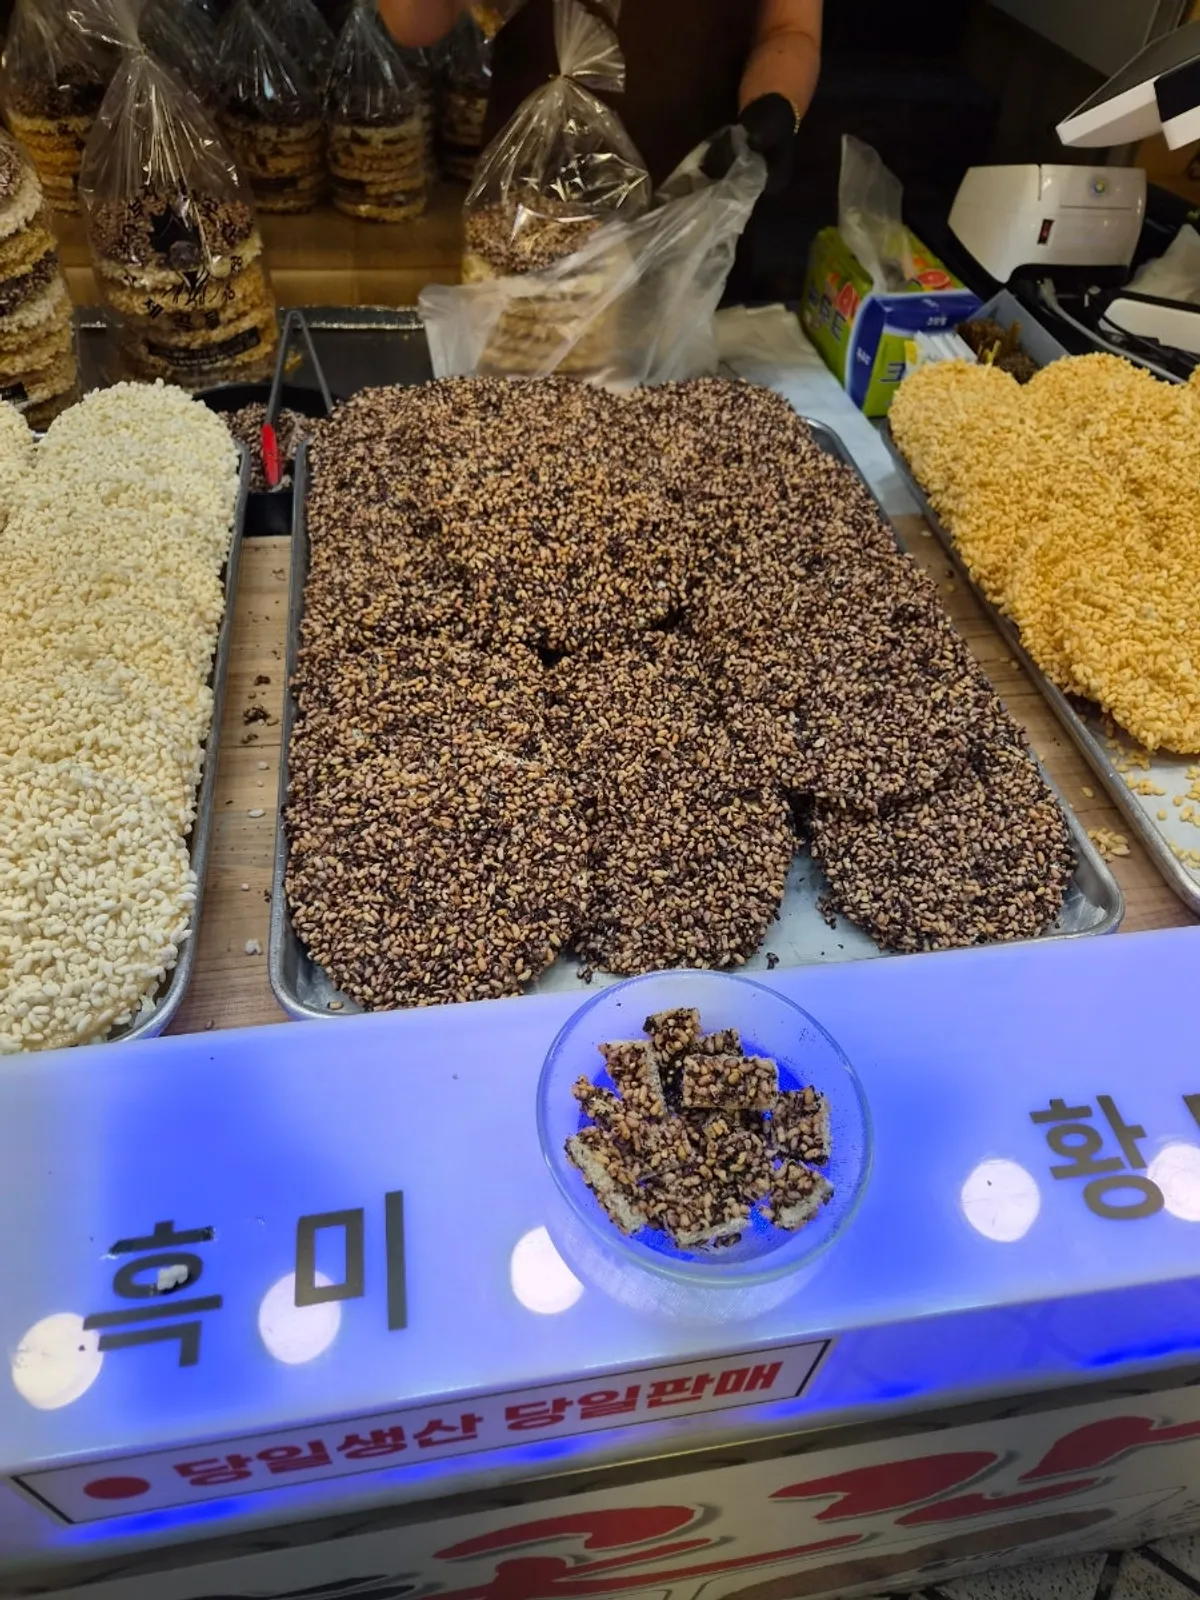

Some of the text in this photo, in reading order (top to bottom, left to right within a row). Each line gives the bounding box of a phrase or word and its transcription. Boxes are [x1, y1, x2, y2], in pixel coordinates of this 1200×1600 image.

[82, 1190, 407, 1367] 흑미
[173, 1361, 783, 1487] 당일생산 당일판매
